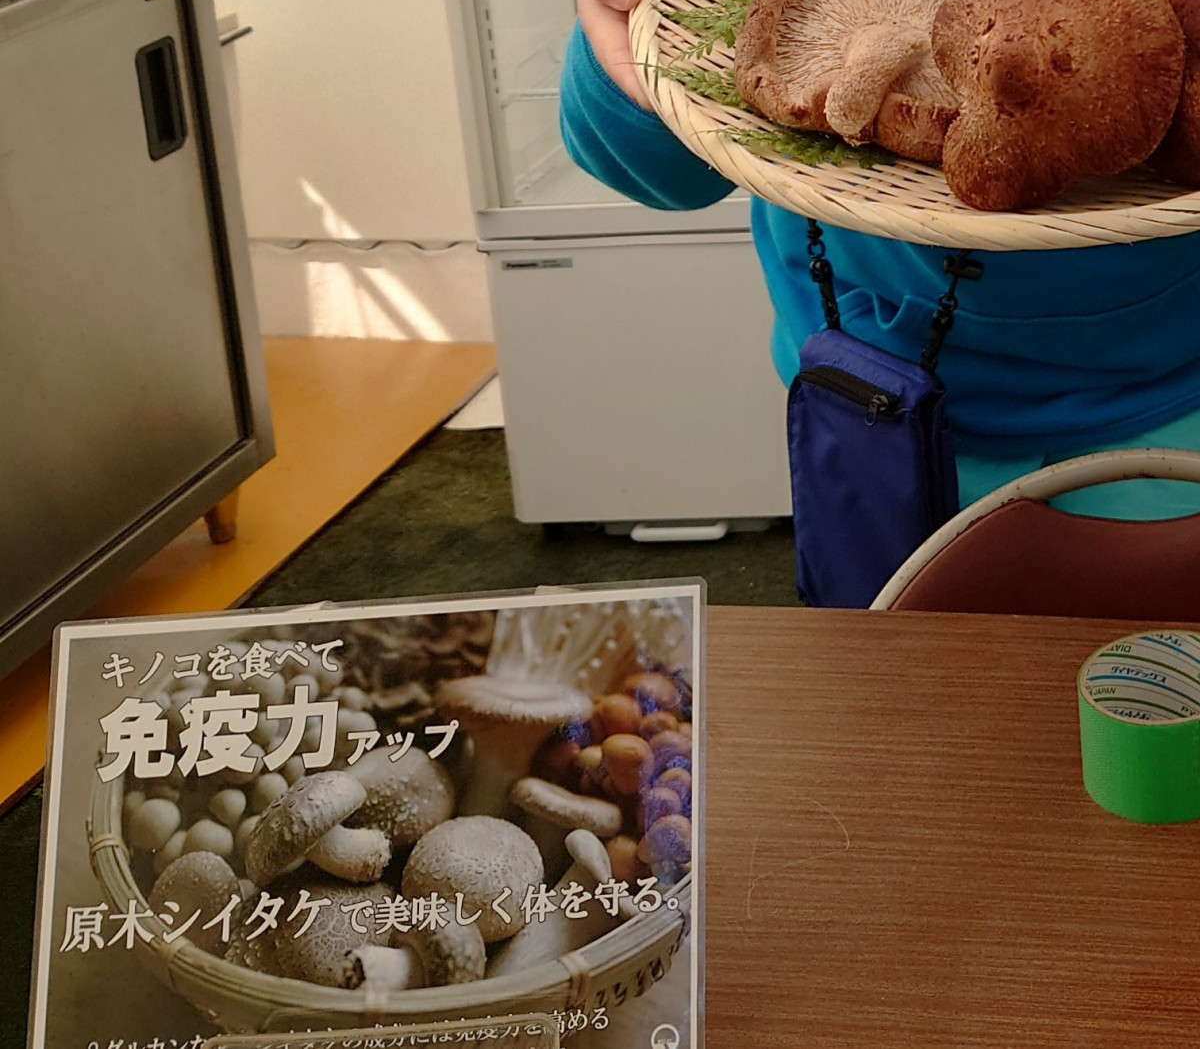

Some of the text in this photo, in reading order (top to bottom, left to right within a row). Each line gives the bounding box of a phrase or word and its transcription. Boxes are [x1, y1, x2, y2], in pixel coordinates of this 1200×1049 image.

[102, 639, 345, 688] キノコを食べて
[97, 685, 460, 784] 免疫力アップ
